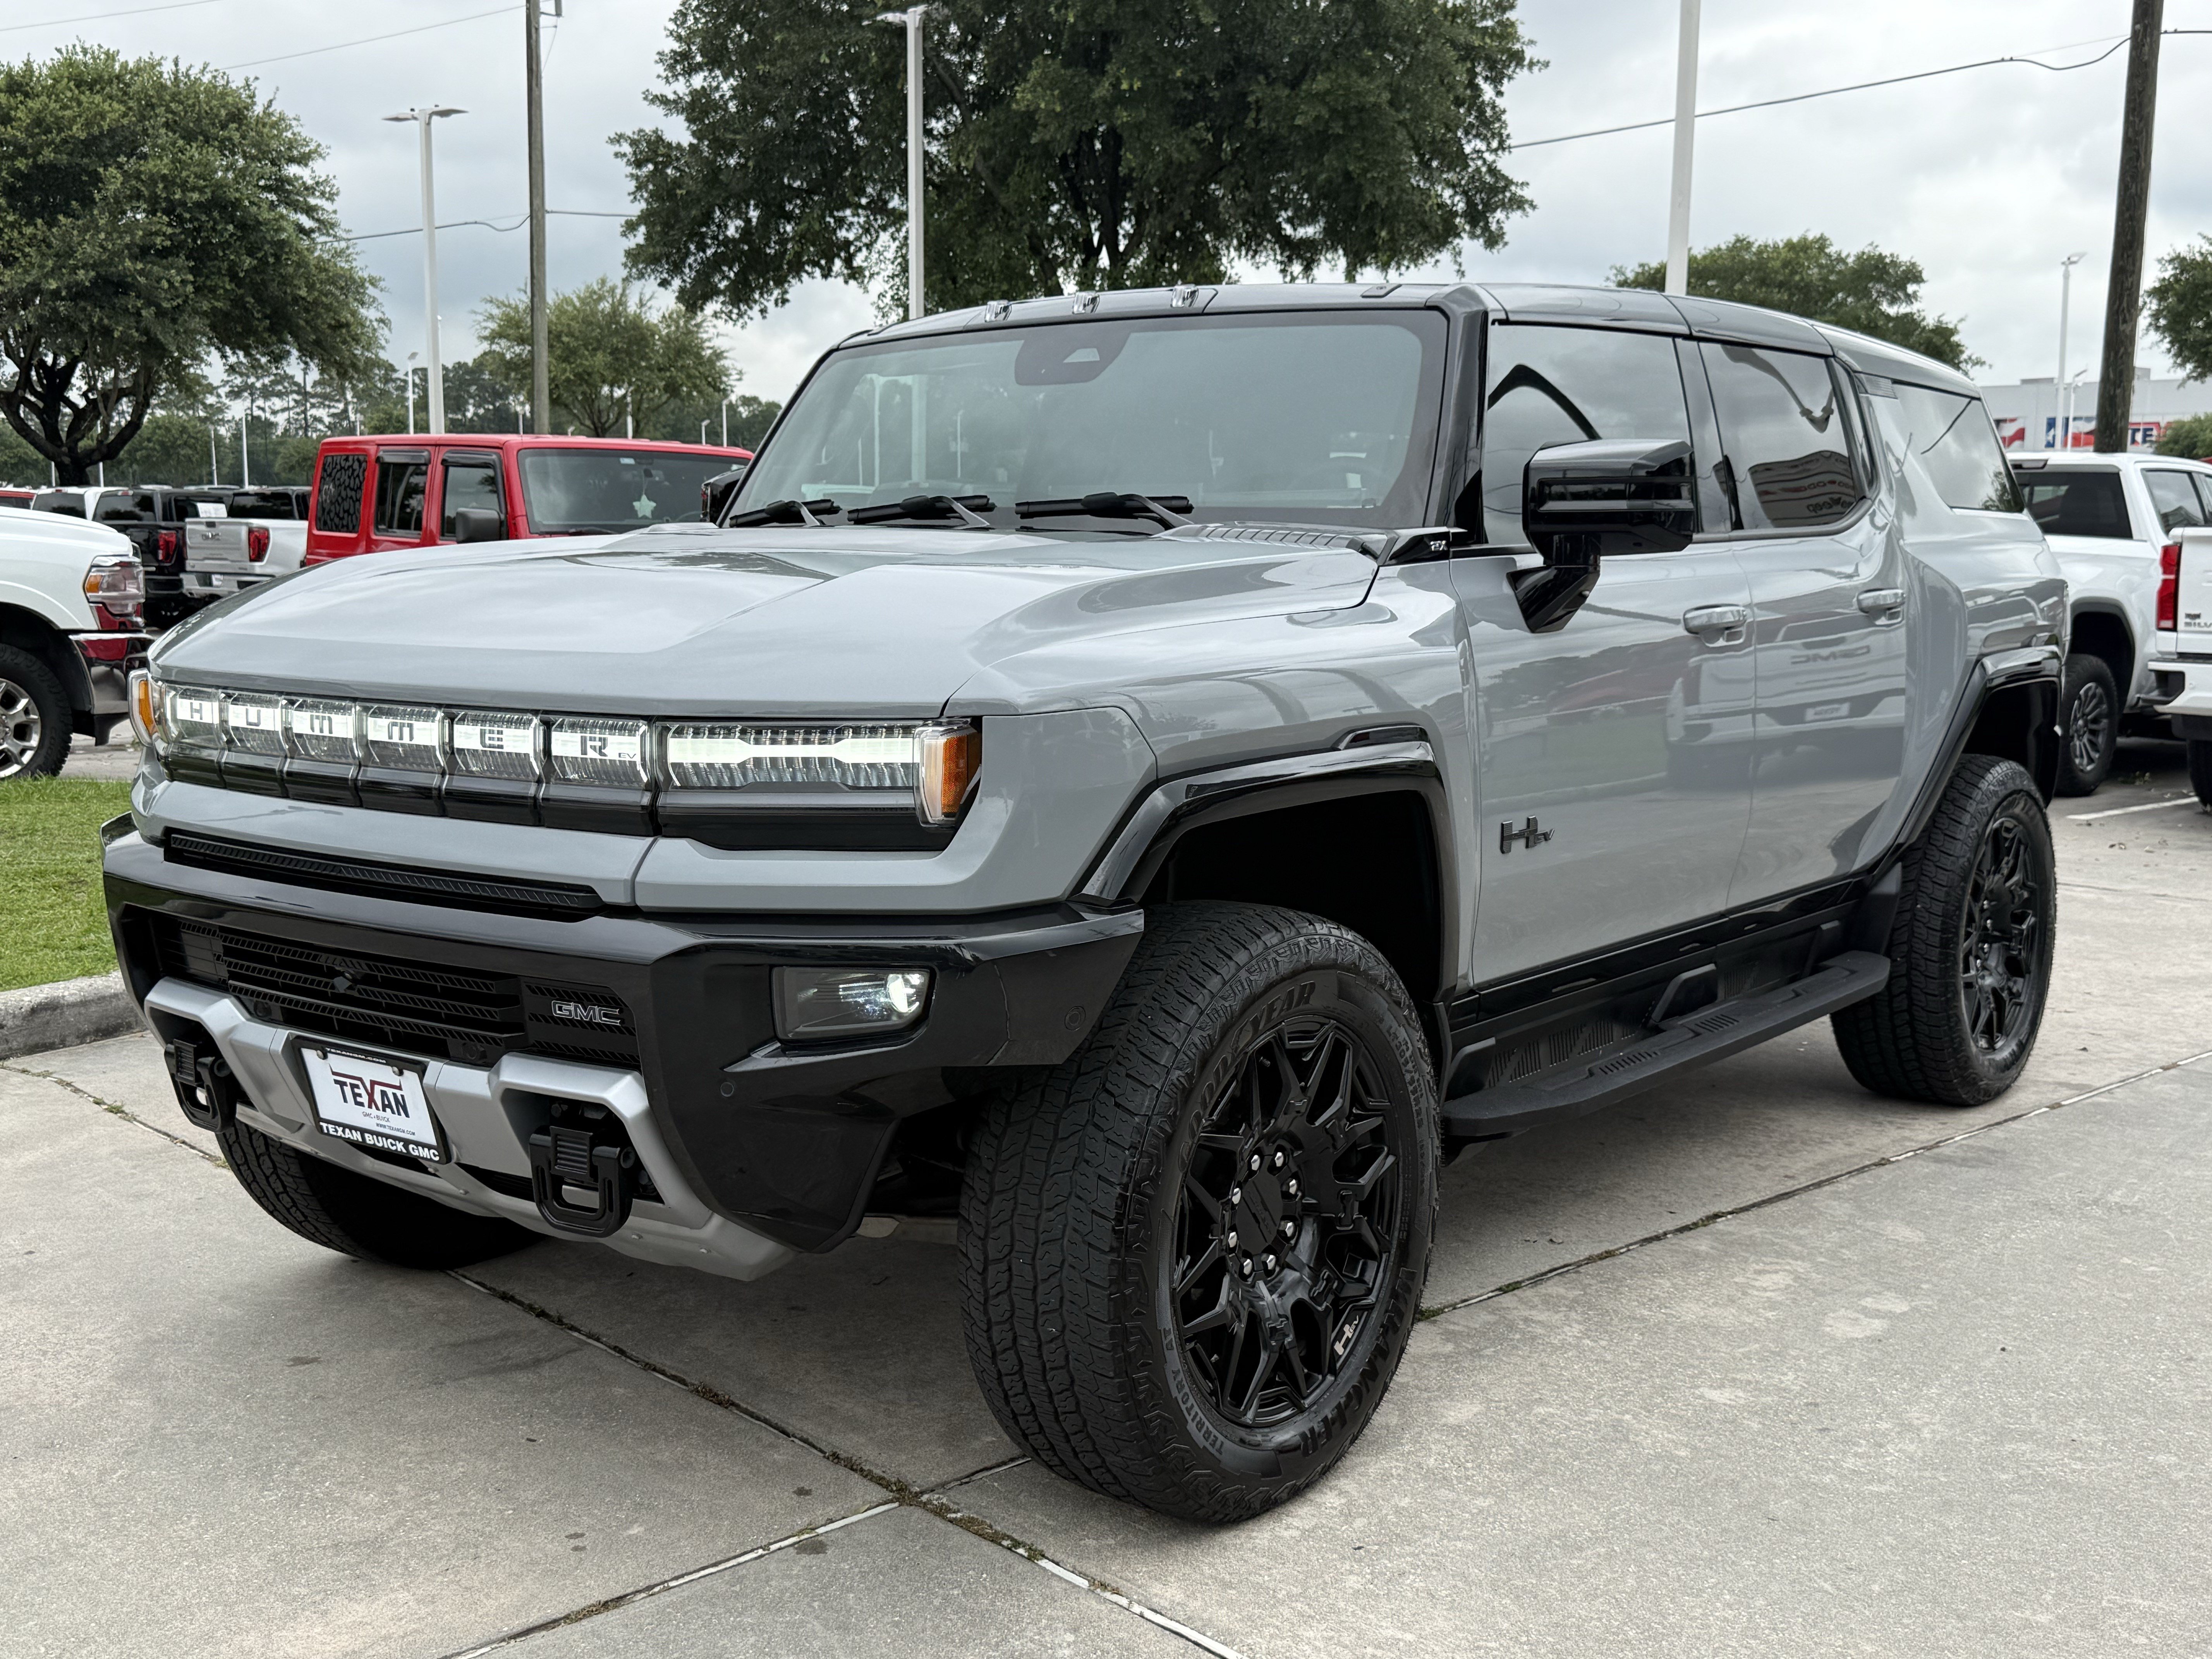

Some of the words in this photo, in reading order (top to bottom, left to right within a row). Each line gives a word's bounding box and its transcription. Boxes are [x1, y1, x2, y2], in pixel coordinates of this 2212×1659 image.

[189, 699, 608, 757] HUMMER
[551, 1000, 621, 1026] GMC
[333, 1078, 410, 1118] TEXAN
[376, 1115, 390, 1123] BUICK
[319, 1121, 362, 1142] TEXAN
[364, 1133, 407, 1153] BUICK
[409, 1144, 440, 1161] GMC
[1163, 1328, 1174, 1350] AT
[1171, 1368, 1225, 1455] TERRITORY
